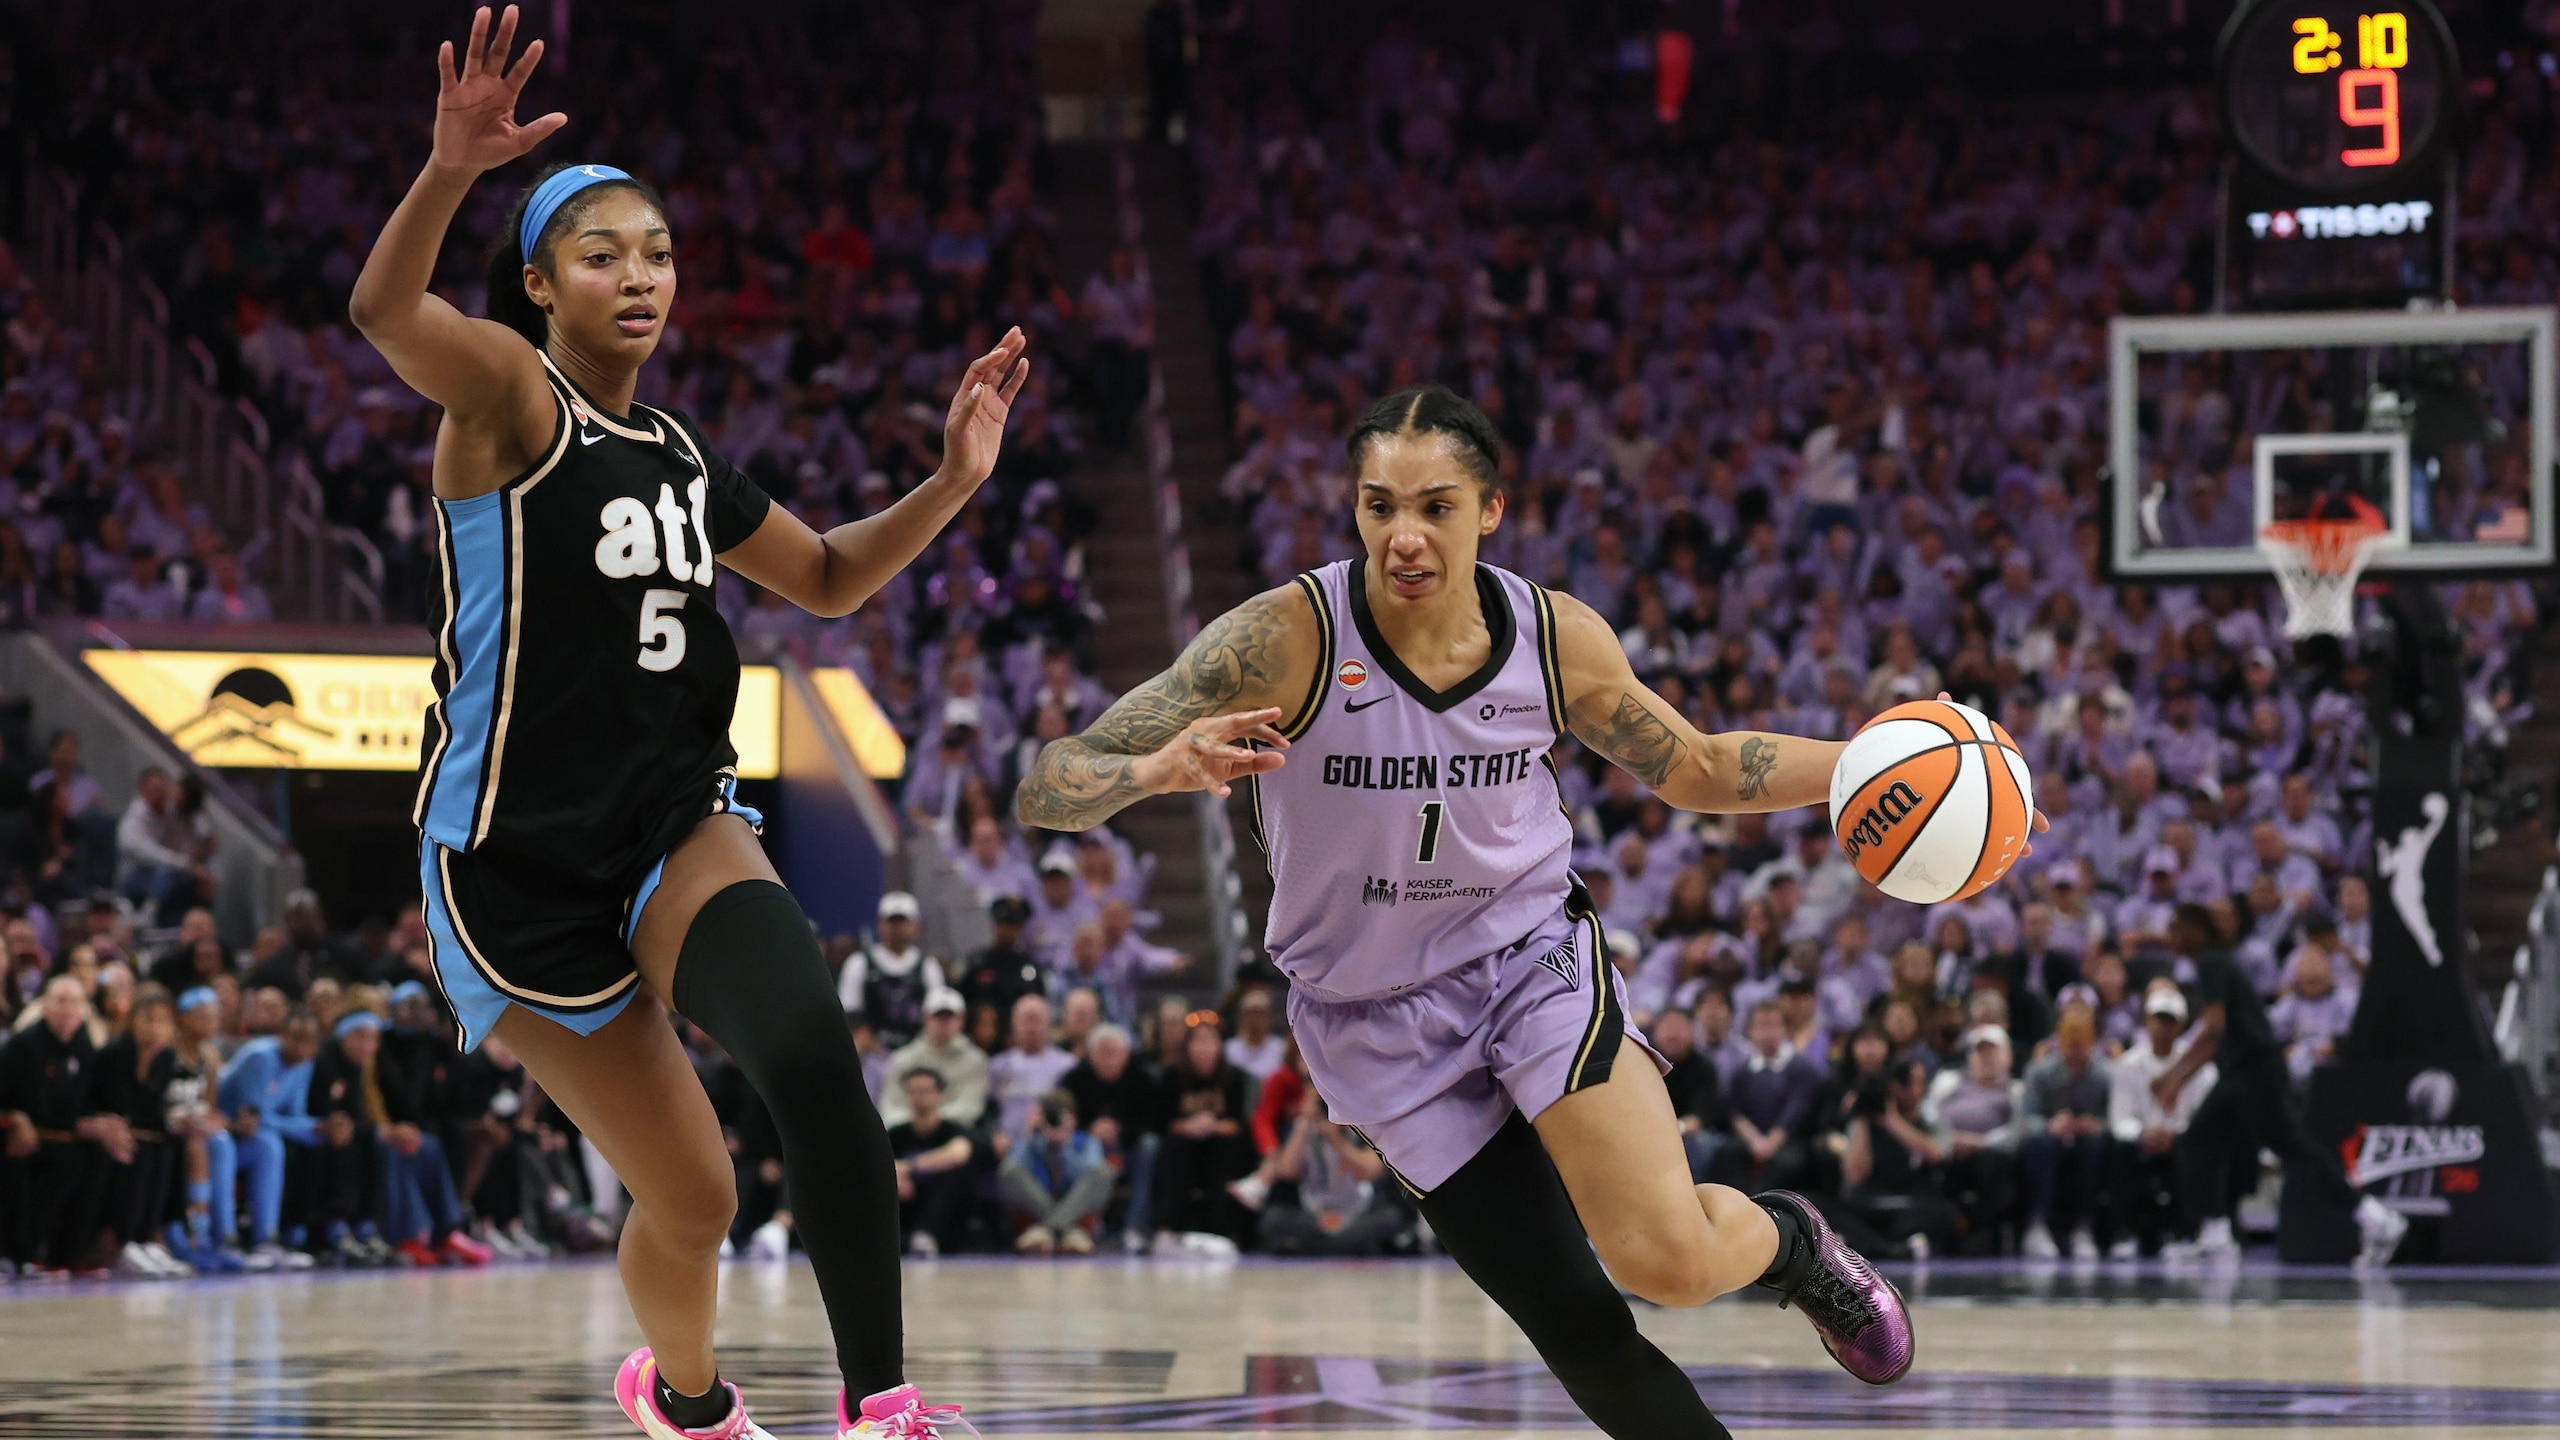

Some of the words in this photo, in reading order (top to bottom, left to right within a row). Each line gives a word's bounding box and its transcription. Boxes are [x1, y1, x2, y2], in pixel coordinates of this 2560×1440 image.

[2292, 12, 2409, 74] 2:10
[2338, 68, 2401, 168] 9
[2296, 200, 2433, 240] TISSOT
[594, 475, 714, 588] atl
[637, 588, 690, 673] 5
[1499, 704, 1542, 718] freedom
[1323, 754, 1438, 790] GOLDEN
[1446, 747, 1532, 788] STATE
[1415, 800, 1446, 864] 1
[1403, 887, 1497, 902] PERMANENTE
[1406, 878, 1454, 889] KAISER
